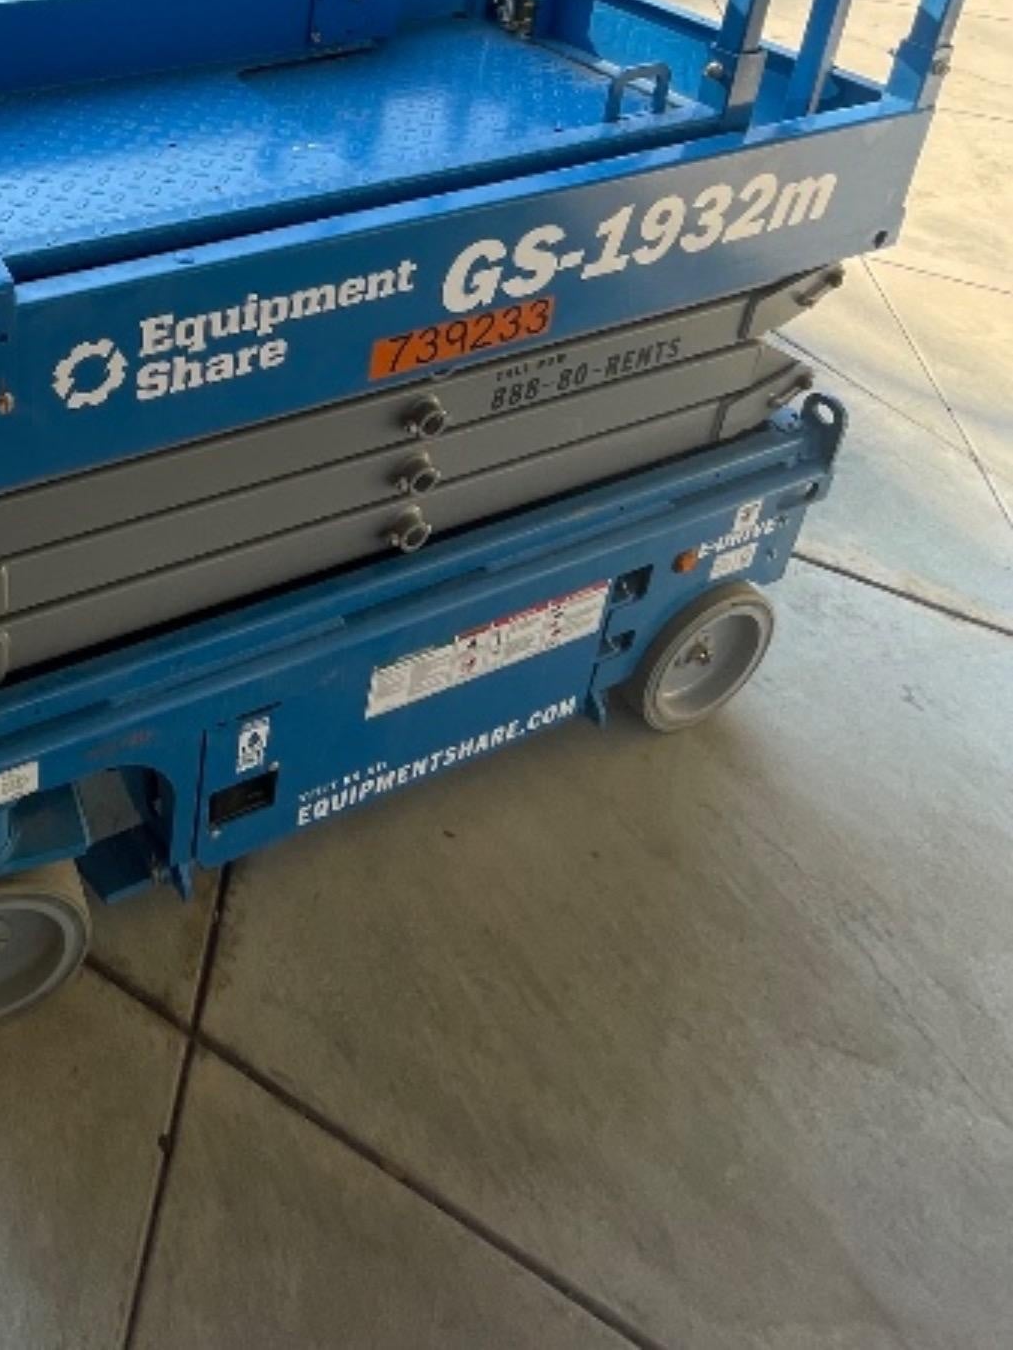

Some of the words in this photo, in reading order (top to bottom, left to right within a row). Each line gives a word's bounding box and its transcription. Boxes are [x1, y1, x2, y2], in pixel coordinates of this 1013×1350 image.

[441, 172, 838, 313] GS-1932m
[138, 259, 418, 358] Equipment
[388, 298, 550, 373] 739233
[135, 338, 288, 401] Share
[490, 335, 682, 411] 888-80-RENTS
[296, 695, 578, 826] EQUIPMENTSHARE.COM
